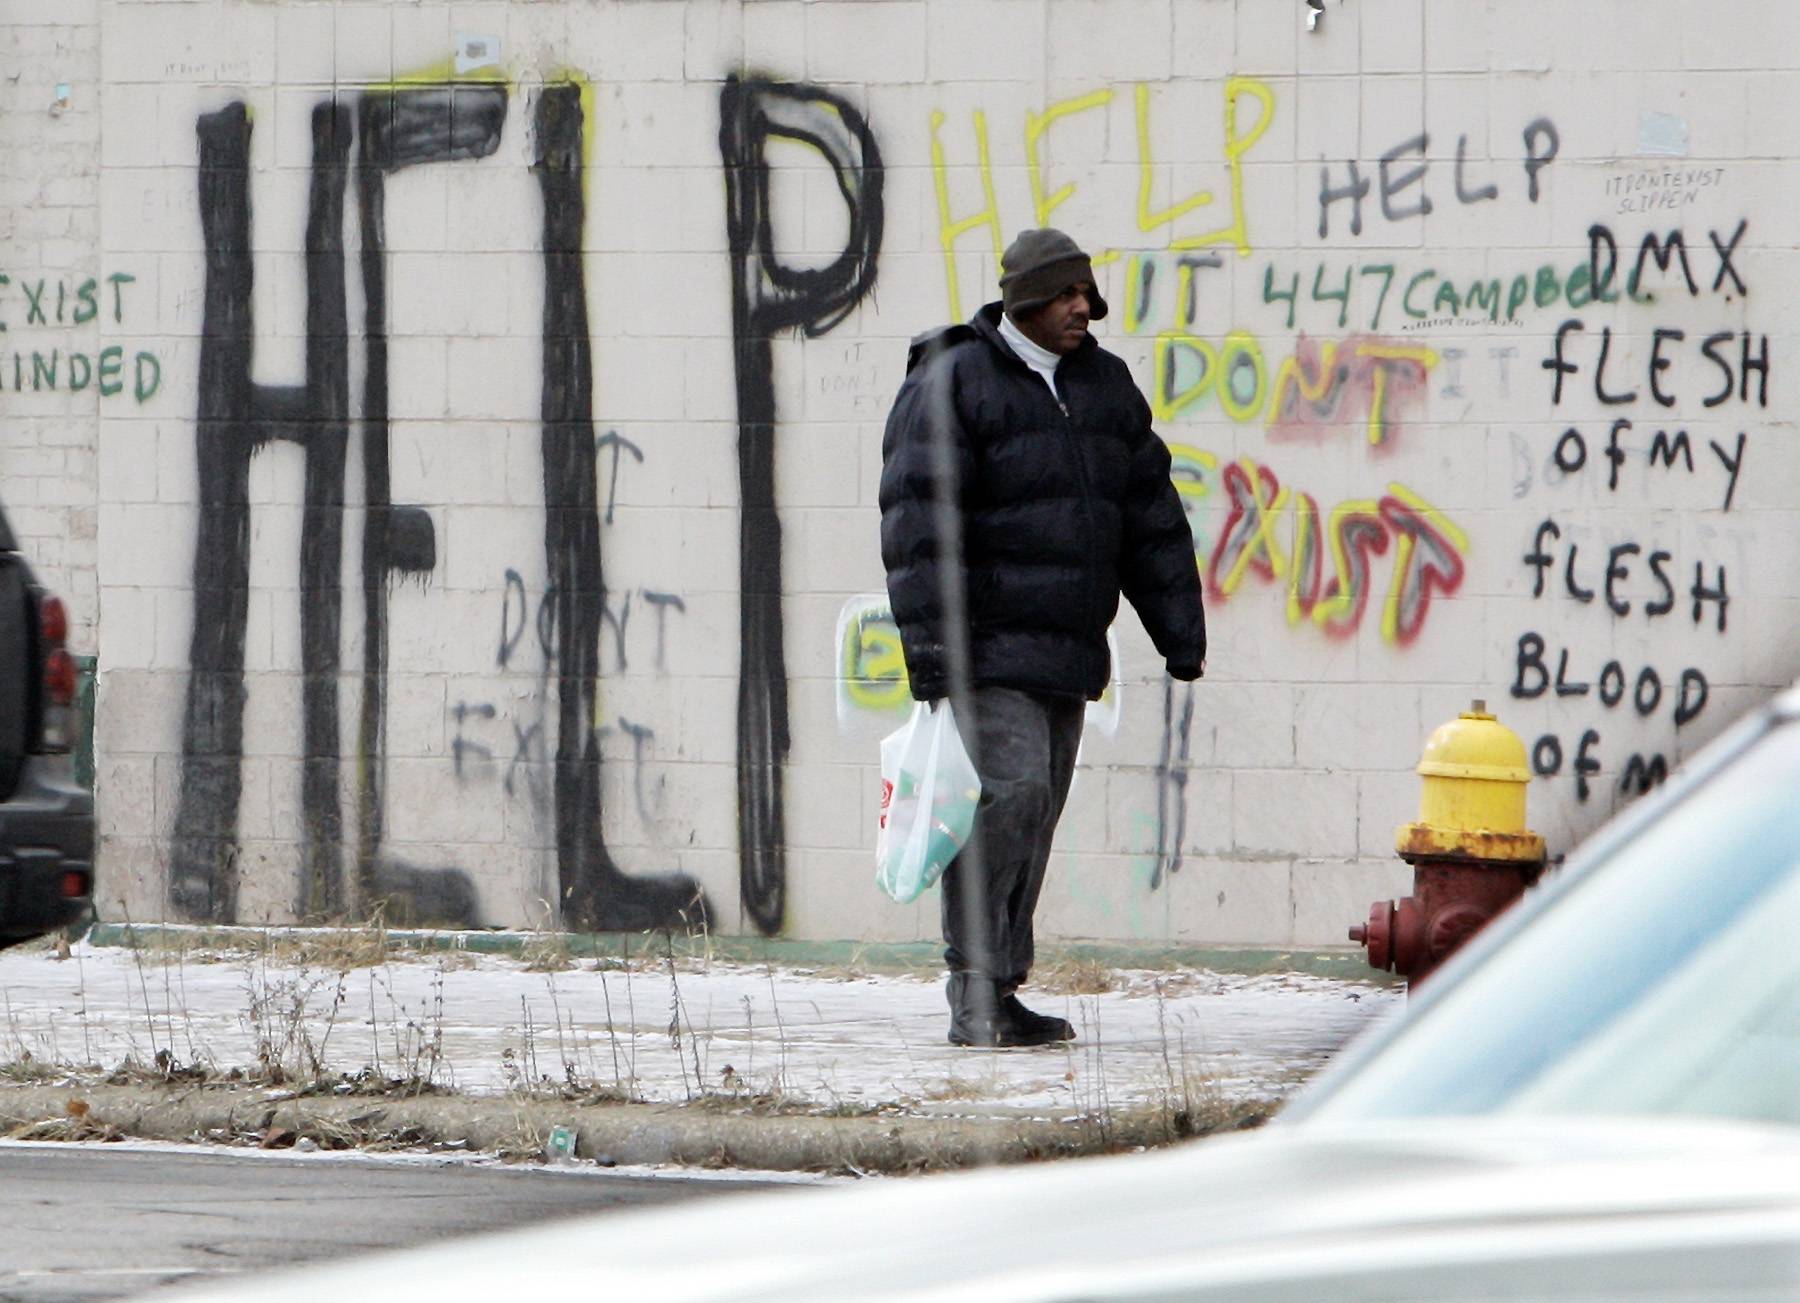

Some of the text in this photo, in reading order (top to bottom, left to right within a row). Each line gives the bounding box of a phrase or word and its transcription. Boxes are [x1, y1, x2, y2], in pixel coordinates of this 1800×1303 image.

[930, 76, 1275, 323] HELP
[1318, 117, 1560, 239] HELP
[1123, 252, 1222, 333] IT
[1263, 262, 1394, 331] 447
[1588, 219, 1748, 301] DMX
[0, 272, 136, 332] XIST
[0, 346, 161, 405] INDED
[168, 72, 888, 937] HELP
[1510, 631, 1709, 727] BLOOD
